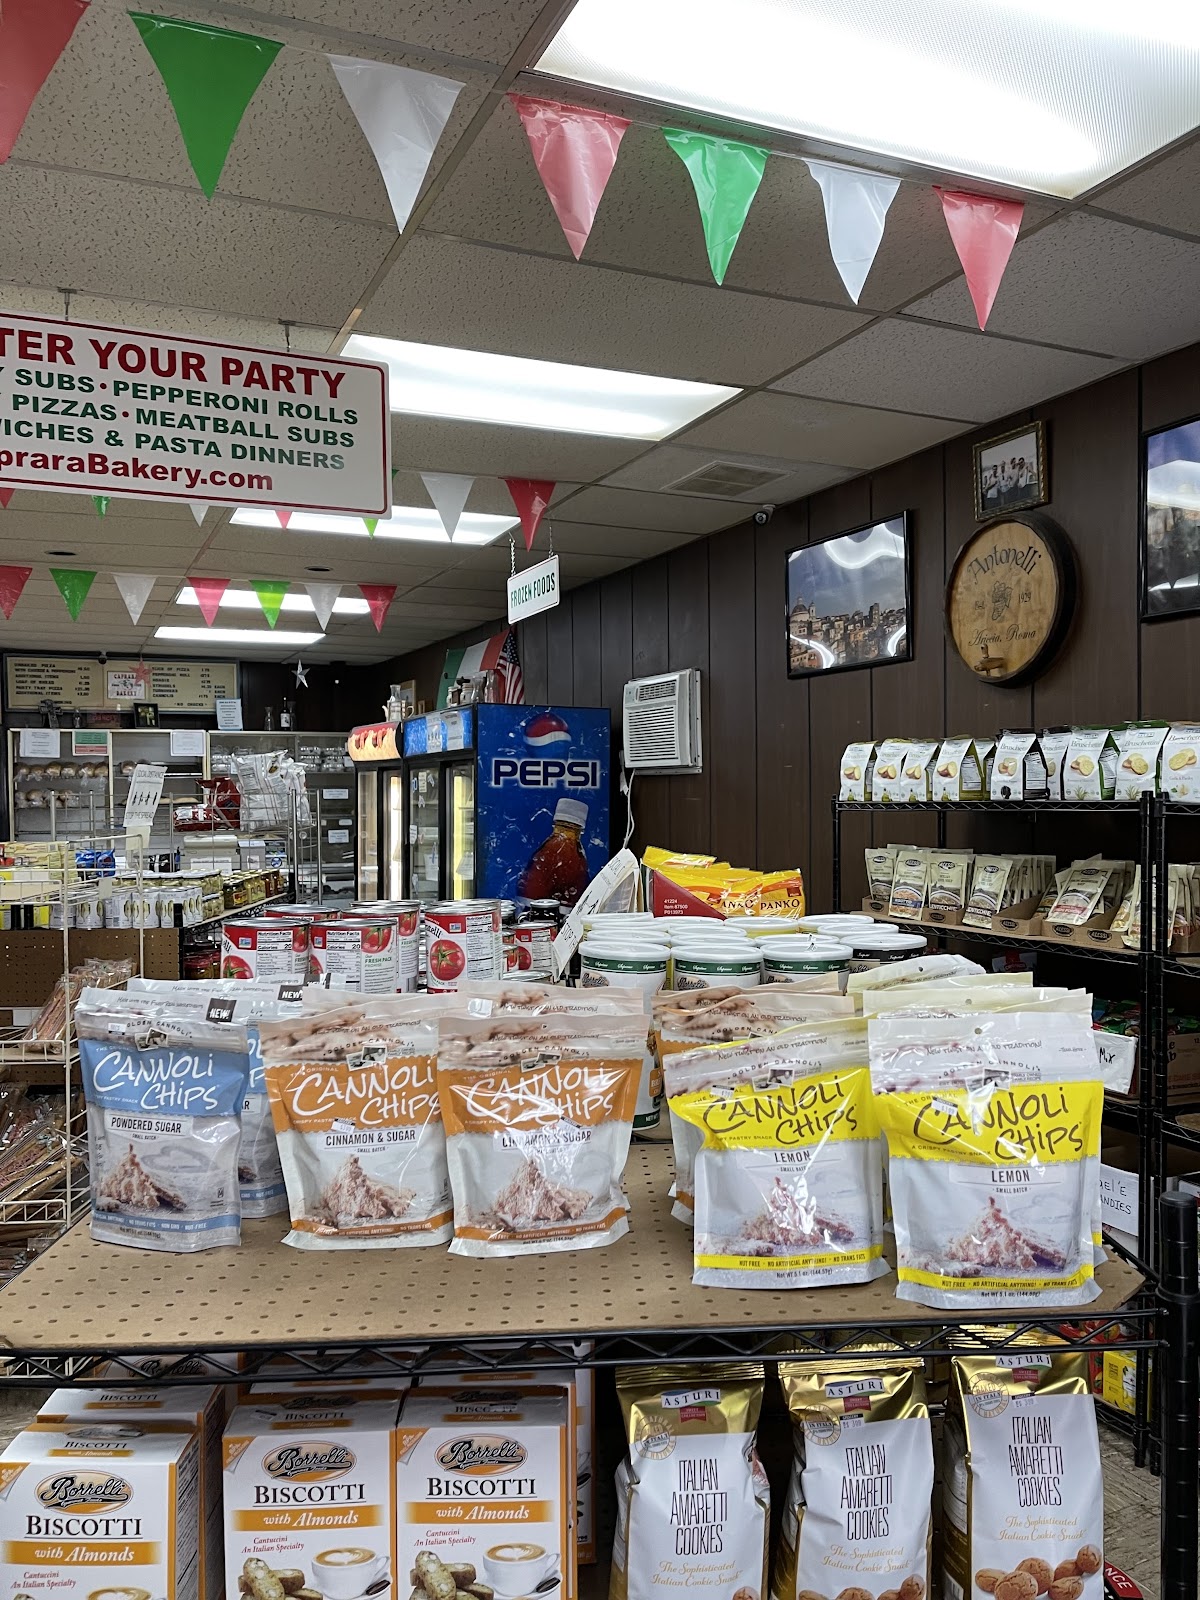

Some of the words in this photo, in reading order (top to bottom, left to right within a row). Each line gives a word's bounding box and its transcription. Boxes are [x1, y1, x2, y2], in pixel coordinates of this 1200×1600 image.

[0, 328, 76, 366] TER
[89, 339, 208, 382] YOUR
[221, 357, 346, 398] PARTY
[15, 369, 95, 393] SUBS
[113, 380, 268, 414] PEPPERONI
[278, 401, 358, 424] ROLLS
[12, 394, 117, 421] PIZZAS
[136, 408, 279, 440] MEATBALL
[287, 426, 355, 447] SUBS
[0, 418, 94, 444] ICHES
[104, 430, 125, 447] &
[135, 433, 222, 457] PASTA
[231, 444, 345, 470] DINNERS
[0, 449, 273, 490] praraBakery.com
[967, 544, 1041, 585] Antonelli
[510, 582, 532, 608] FROZEN
[532, 571, 556, 598] FOODS
[1006, 623, 1036, 641] Roma
[494, 760, 598, 787] PEPSI
[760, 898, 800, 910] PANKO
[1003, 1040, 1043, 1051] TRADITION!
[93, 1051, 213, 1092] CANNOLI
[140, 1081, 218, 1110] CHIPS
[292, 1058, 435, 1116] CANNOLI
[467, 1062, 606, 1117] CANNOLI
[360, 1091, 442, 1125] CHIPS
[535, 1091, 614, 1125] CHIPS
[703, 1075, 845, 1134] CANNOLI
[111, 1118, 153, 1131] POWDERED
[155, 1121, 182, 1134] SUGAR
[775, 1104, 858, 1146] CHIPS
[325, 1132, 375, 1146] CINNAMON
[377, 1132, 384, 1142] &
[386, 1129, 416, 1142] SUGAR
[563, 1130, 592, 1143] SUGAR
[994, 1123, 1083, 1161] CHIPS
[774, 1150, 811, 1164] LEMON
[917, 1144, 942, 1152] CRISPY
[992, 1169, 1030, 1183] LEMON
[995, 1186, 1011, 1194] SMALL
[775, 1259, 801, 1268] ARTIFICIAL
[841, 1254, 856, 1262] TRANS
[856, 1253, 866, 1261] FATS
[776, 1271, 786, 1279] Net
[951, 1280, 966, 1288] FREE
[972, 1280, 980, 1288] NO
[980, 1280, 1009, 1288] ARTIFICIAL
[1009, 1280, 1037, 1288] ANYTHING!
[997, 1355, 1051, 1366] ASTURI
[828, 1381, 884, 1396] ASTURI
[983, 1391, 1001, 1400] ITALY
[664, 1390, 720, 1406] ASTURI
[284, 1412, 344, 1420] BISCOTTI
[1012, 1416, 1052, 1445] ITALIAN
[64, 1441, 128, 1449] BISCOTTI
[440, 1440, 523, 1464] Borrelli
[268, 1447, 353, 1472] Borrelli
[845, 1444, 886, 1476] ITALIAN
[1008, 1444, 1064, 1476] AMARETTI
[678, 1458, 719, 1492] ITALIAN
[41, 1474, 129, 1503] Borrelli
[254, 1483, 365, 1504] BISCOTTI
[426, 1477, 536, 1497] BISCOTTI
[840, 1475, 893, 1509] AMARETTI
[1017, 1476, 1062, 1508] COOKIES
[263, 1513, 291, 1525] with
[292, 1510, 359, 1526] Almonds
[436, 1506, 463, 1518] with
[464, 1505, 530, 1520] Almonds
[670, 1491, 728, 1527] AMARETTI
[25, 1515, 142, 1537] BISCOTTI
[847, 1507, 890, 1541] COOKIES
[1005, 1515, 1023, 1528] The
[1023, 1515, 1078, 1529] Sophisticated
[253, 1535, 288, 1545] Cantuccini
[414, 1539, 425, 1547] An
[425, 1538, 447, 1546] Italian
[447, 1536, 476, 1545] Specialty
[426, 1529, 460, 1538] Cantuccini
[675, 1524, 723, 1556] COOKIES
[997, 1531, 1030, 1541] Italian
[1030, 1529, 1056, 1541] Cookie
[1057, 1529, 1084, 1540] Snack
[35, 1547, 63, 1559] with
[64, 1546, 135, 1562] Almonds
[241, 1546, 252, 1554] An
[252, 1544, 275, 1553] Italian
[275, 1542, 305, 1552] Specialty
[829, 1544, 849, 1556] The
[849, 1545, 905, 1560] Sophisticated
[658, 1561, 678, 1573] The
[679, 1560, 736, 1575] Sophisticated
[821, 1556, 854, 1570] Italian
[854, 1559, 882, 1572] Cookie
[883, 1557, 910, 1572] Snack
[10, 1580, 22, 1589] An
[22, 1579, 46, 1589] Italian
[46, 1579, 77, 1589] Specialty
[23, 1571, 60, 1579] Cantuccini
[650, 1574, 684, 1587] Italian
[684, 1573, 714, 1587] Cookie
[715, 1570, 742, 1586] Snack
[1105, 1566, 1132, 1590] NCE
